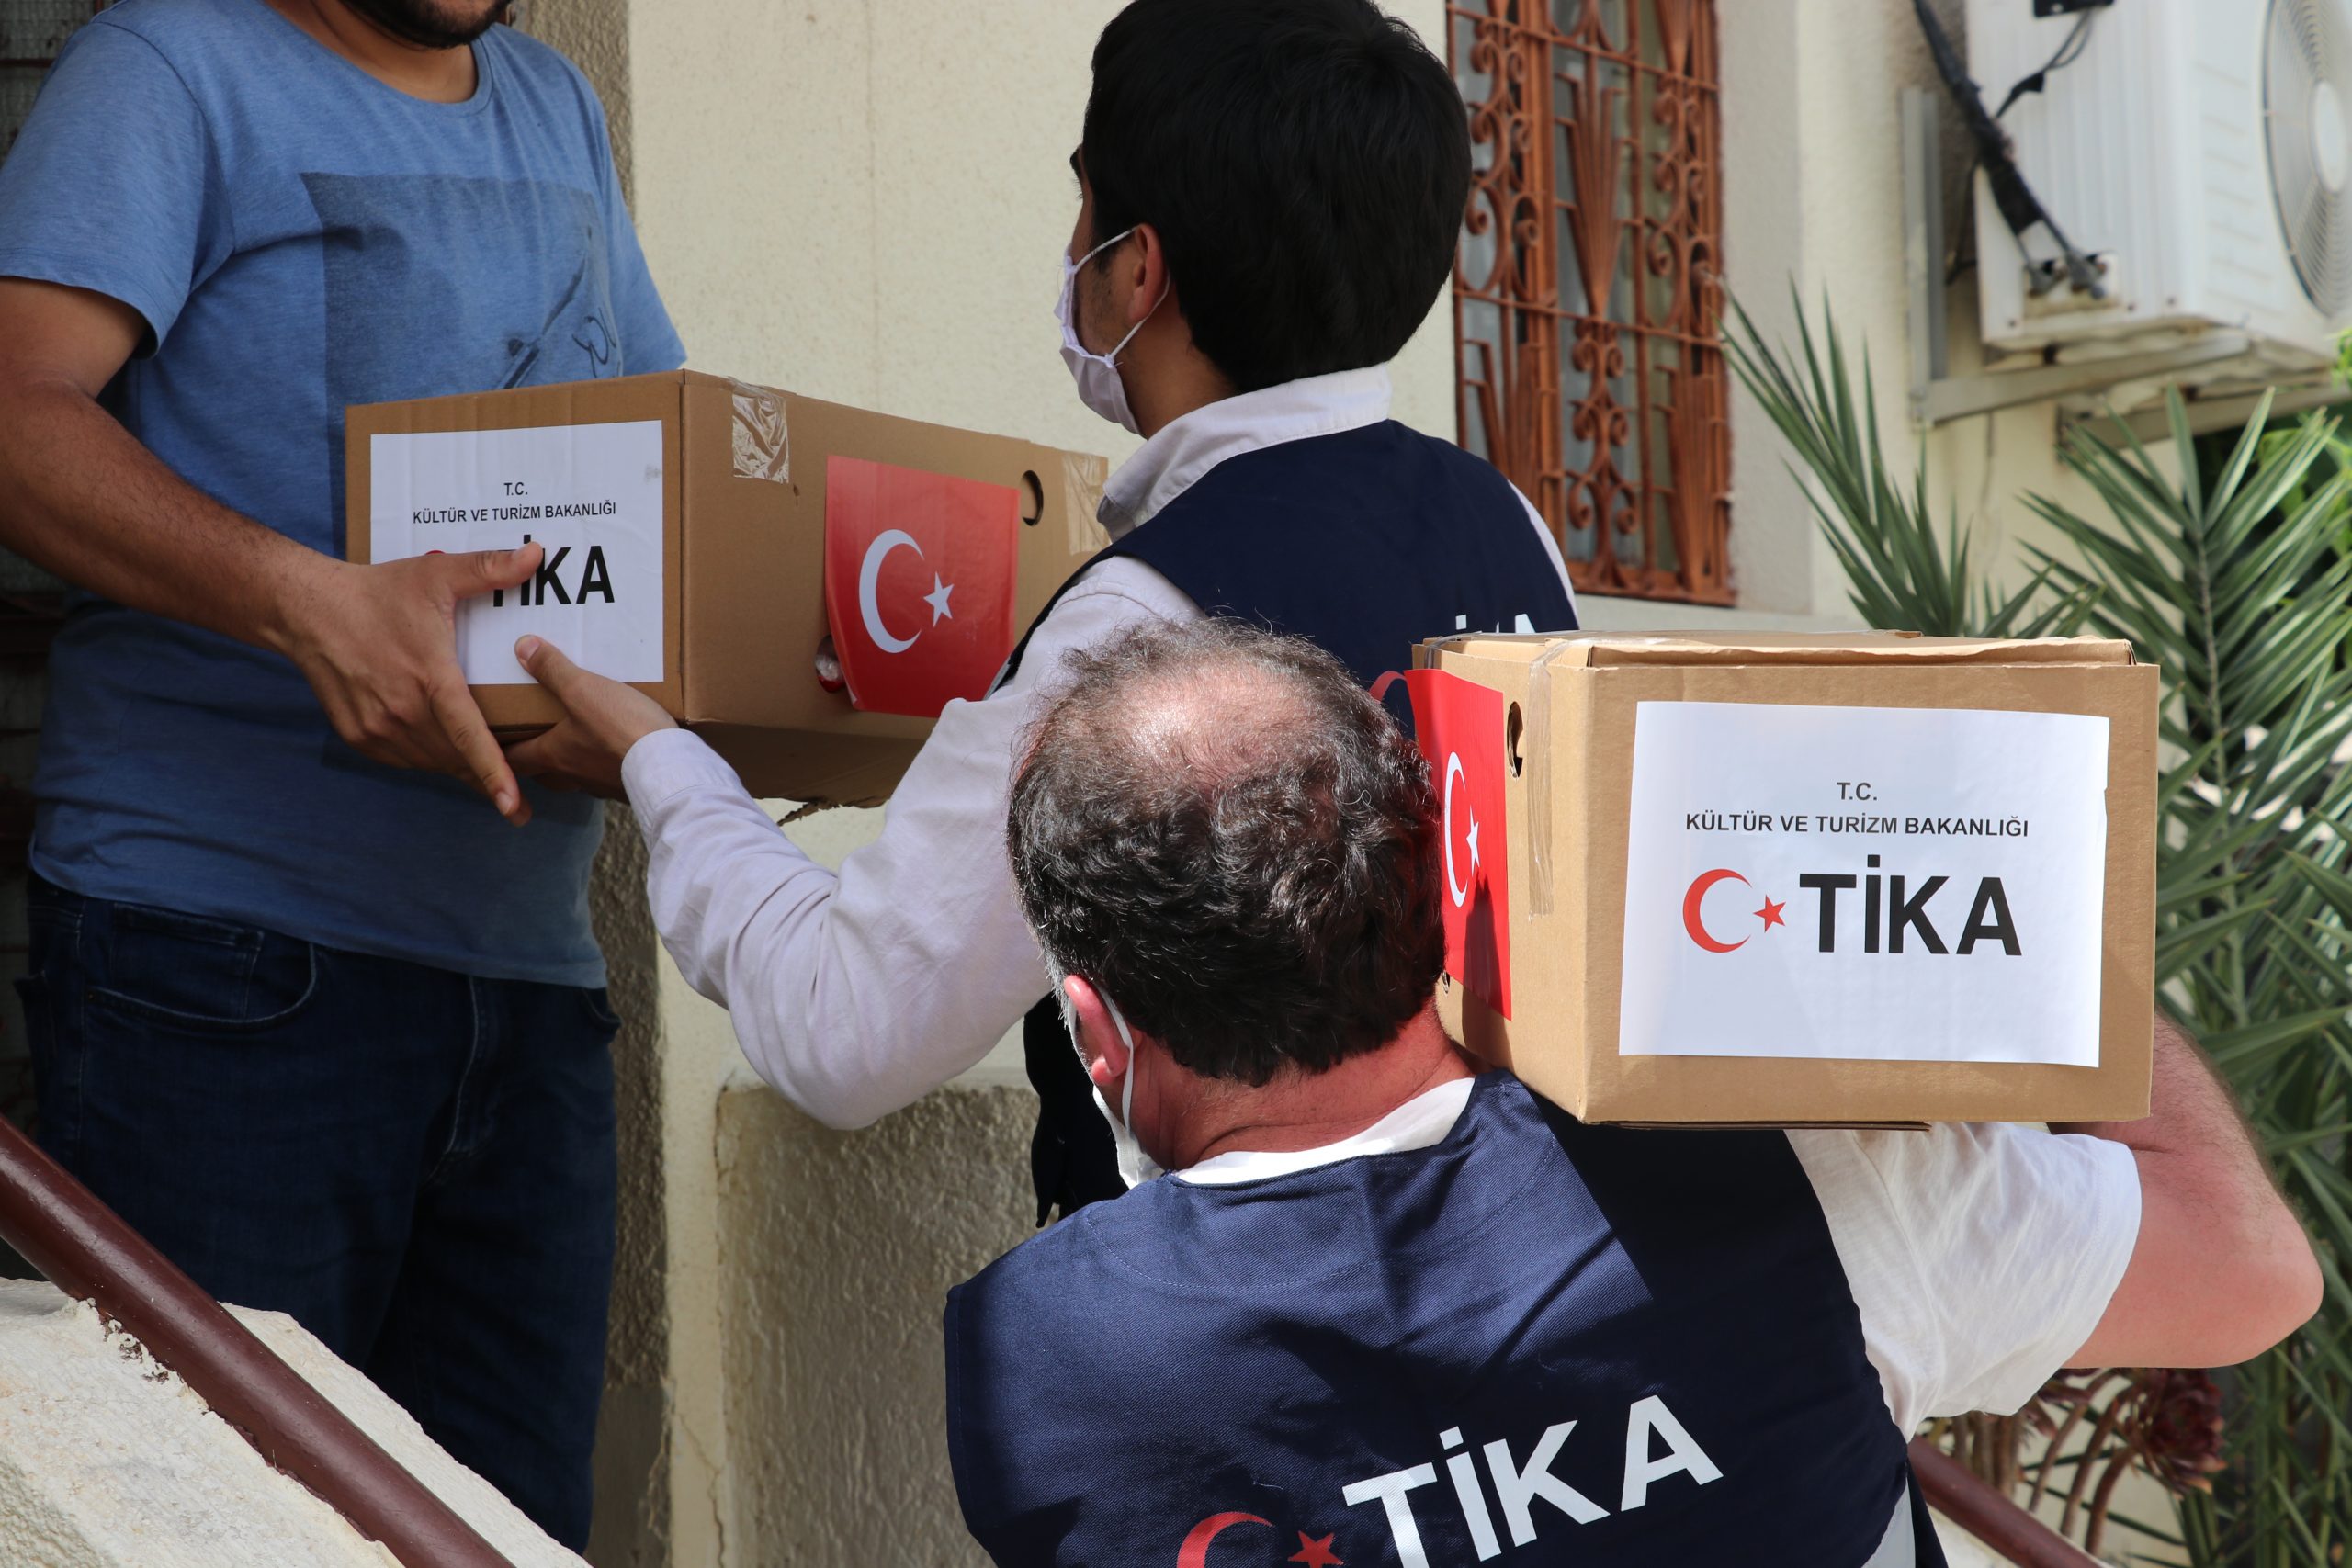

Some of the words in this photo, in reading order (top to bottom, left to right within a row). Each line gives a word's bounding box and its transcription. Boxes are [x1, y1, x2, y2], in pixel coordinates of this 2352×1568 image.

[504, 482, 528, 496] T.C.
[413, 507, 468, 524] KÜLTÜR
[470, 509, 488, 522] VE
[492, 503, 541, 520] TURİZM
[545, 499, 616, 518] BAKANLIĞI
[492, 534, 615, 607] İKA
[1837, 782, 1878, 801] T.C.
[1685, 810, 1773, 832] KÜLTÜR
[1780, 815, 1808, 832] VE
[1815, 811, 1898, 834] TURİZM
[1904, 813, 2029, 837] BAKANLIĞI
[1799, 854, 2022, 956] TİKA
[1341, 1394, 1724, 1568] TİKA
